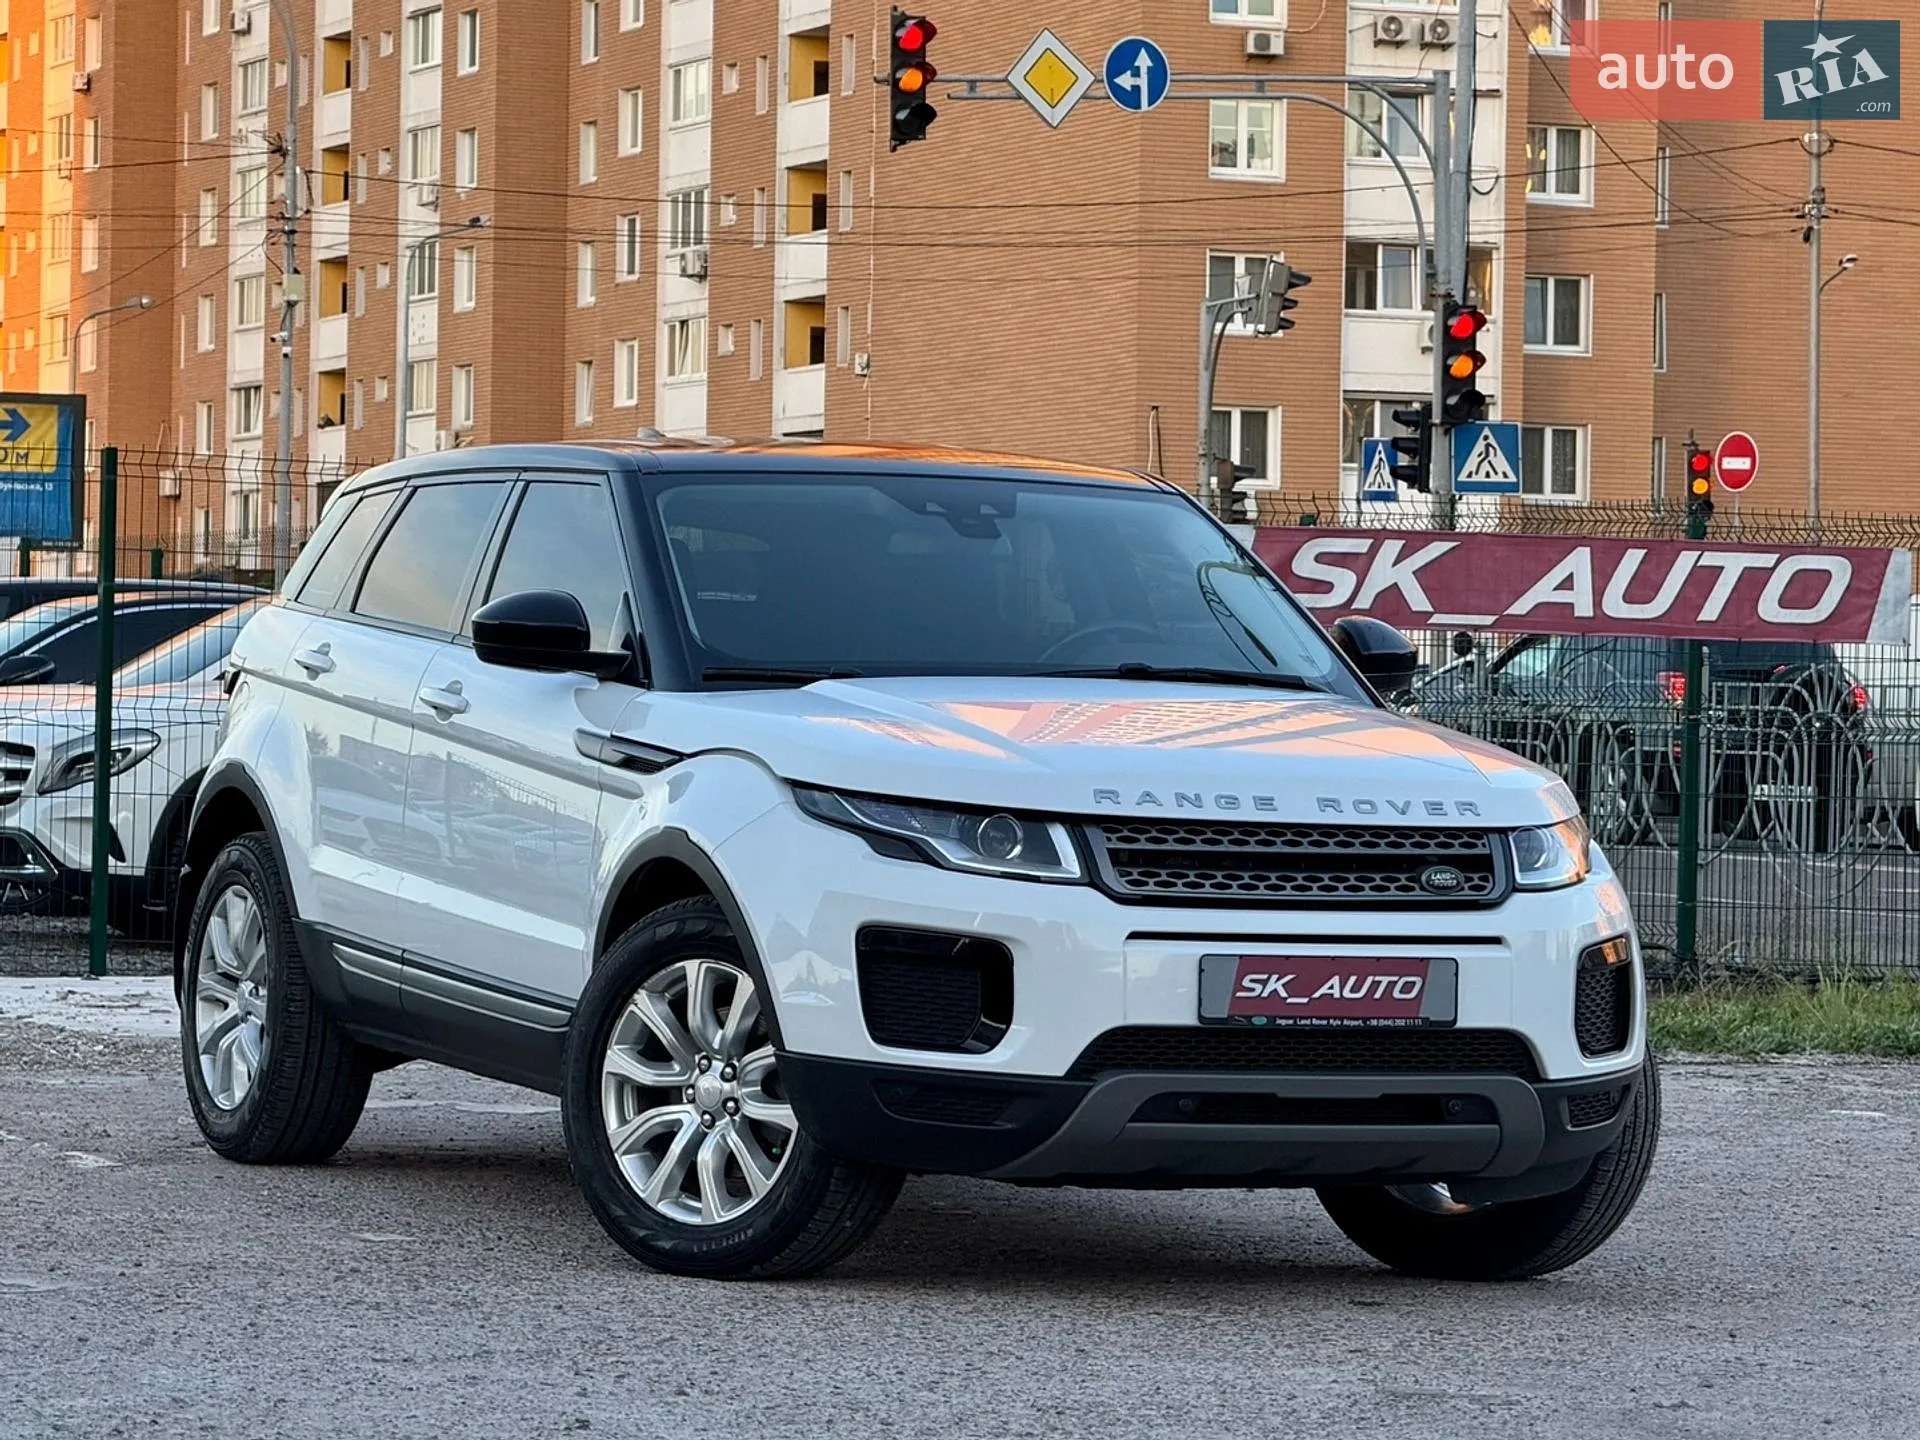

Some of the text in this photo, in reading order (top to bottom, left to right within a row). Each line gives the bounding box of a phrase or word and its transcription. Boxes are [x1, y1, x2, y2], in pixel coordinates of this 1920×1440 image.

[1290, 537, 1852, 625] SK_AUTO
[1093, 788, 1279, 812] RANGE
[1317, 796, 1481, 817] ROVER
[1235, 973, 1423, 1004] SK_AUTO
[1296, 1017, 1311, 1025] Land
[1312, 1018, 1328, 1026] Rover
